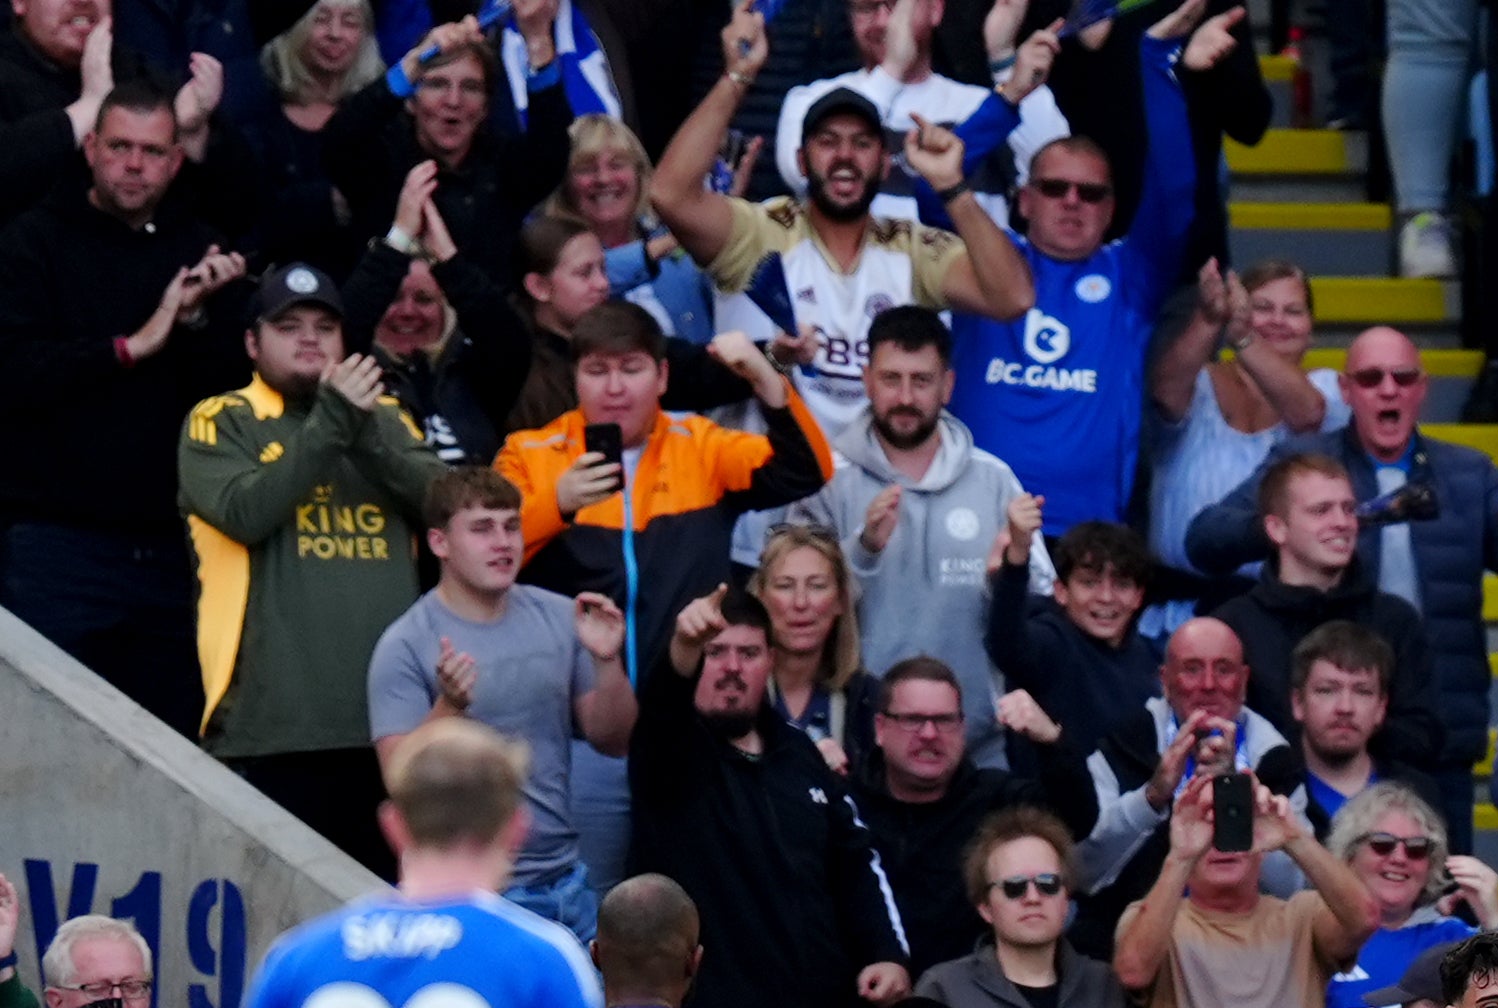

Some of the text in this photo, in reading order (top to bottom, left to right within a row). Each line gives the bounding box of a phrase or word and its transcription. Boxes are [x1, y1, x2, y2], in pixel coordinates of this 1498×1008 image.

[985, 357, 1097, 393] BC.GAME
[296, 503, 387, 534] KING
[297, 535, 390, 560] POWER
